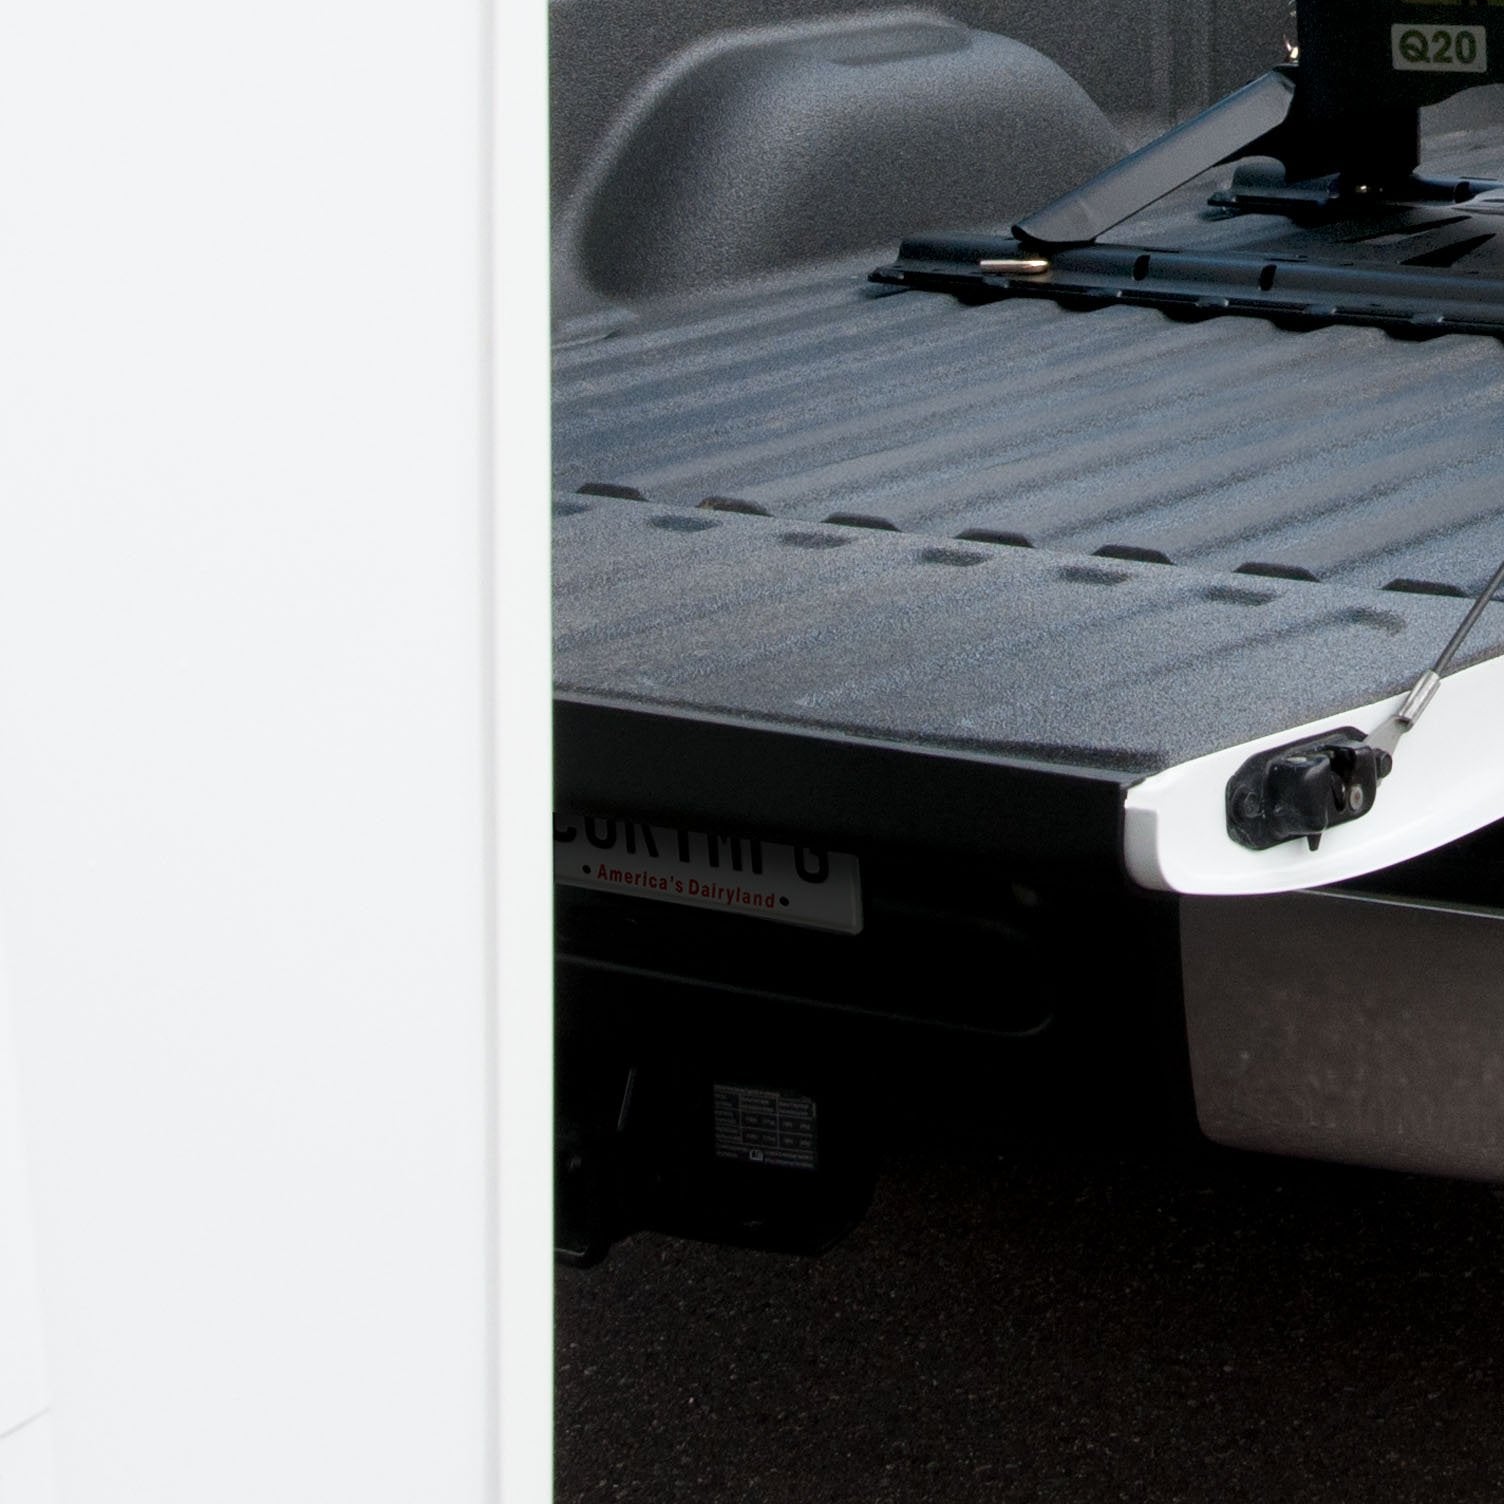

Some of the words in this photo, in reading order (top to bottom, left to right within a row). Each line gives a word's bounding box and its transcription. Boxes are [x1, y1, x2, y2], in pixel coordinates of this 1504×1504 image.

[1400, 29, 1477, 65] Q20
[597, 864, 684, 893] America's
[688, 878, 775, 908] Dairyland
